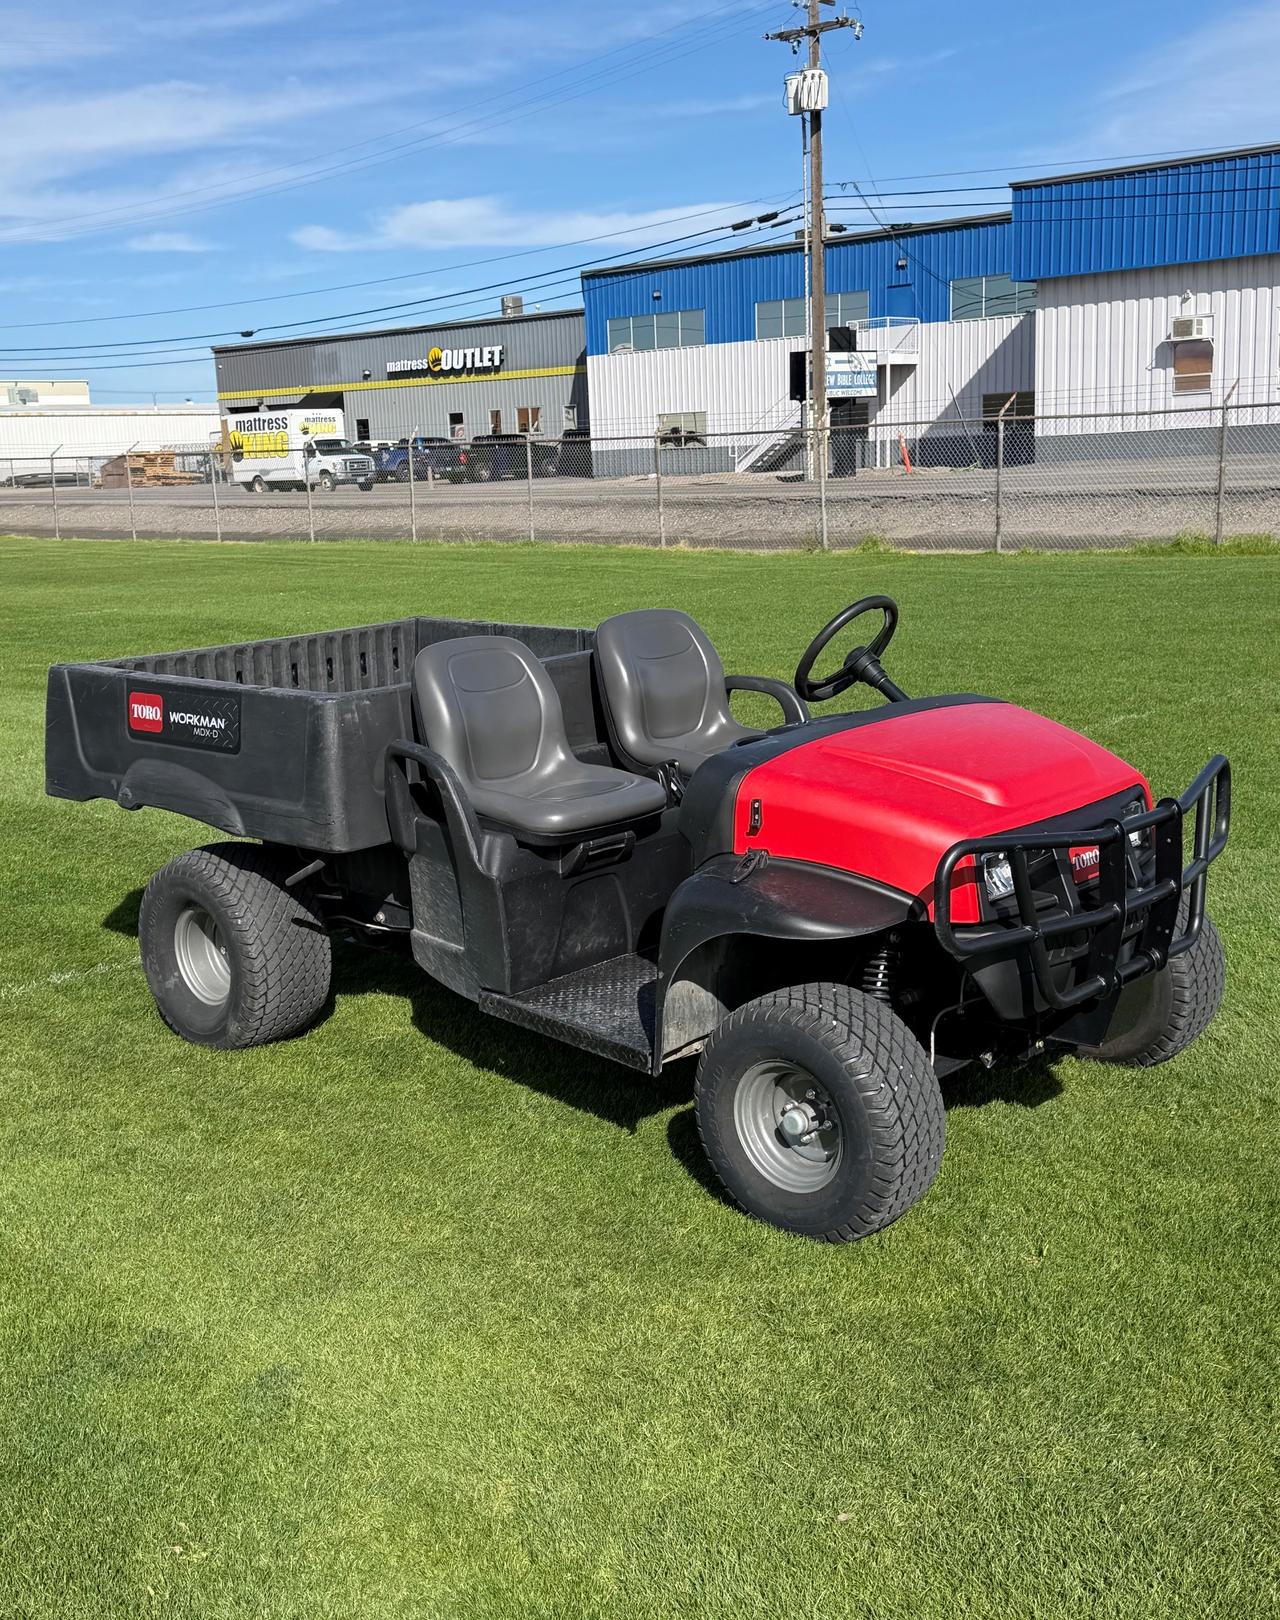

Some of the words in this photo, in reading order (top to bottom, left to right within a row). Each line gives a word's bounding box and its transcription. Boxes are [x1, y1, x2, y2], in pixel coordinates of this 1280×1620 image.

[386, 358, 428, 373] mattress
[441, 345, 503, 371] OUTLET
[235, 416, 288, 432] mattress
[308, 423, 337, 435] KING
[241, 431, 289, 459] KING
[131, 703, 162, 721] TORO
[169, 711, 226, 730] WORKMAN
[193, 727, 219, 738] MDX-D
[1072, 849, 1099, 871] TORO
